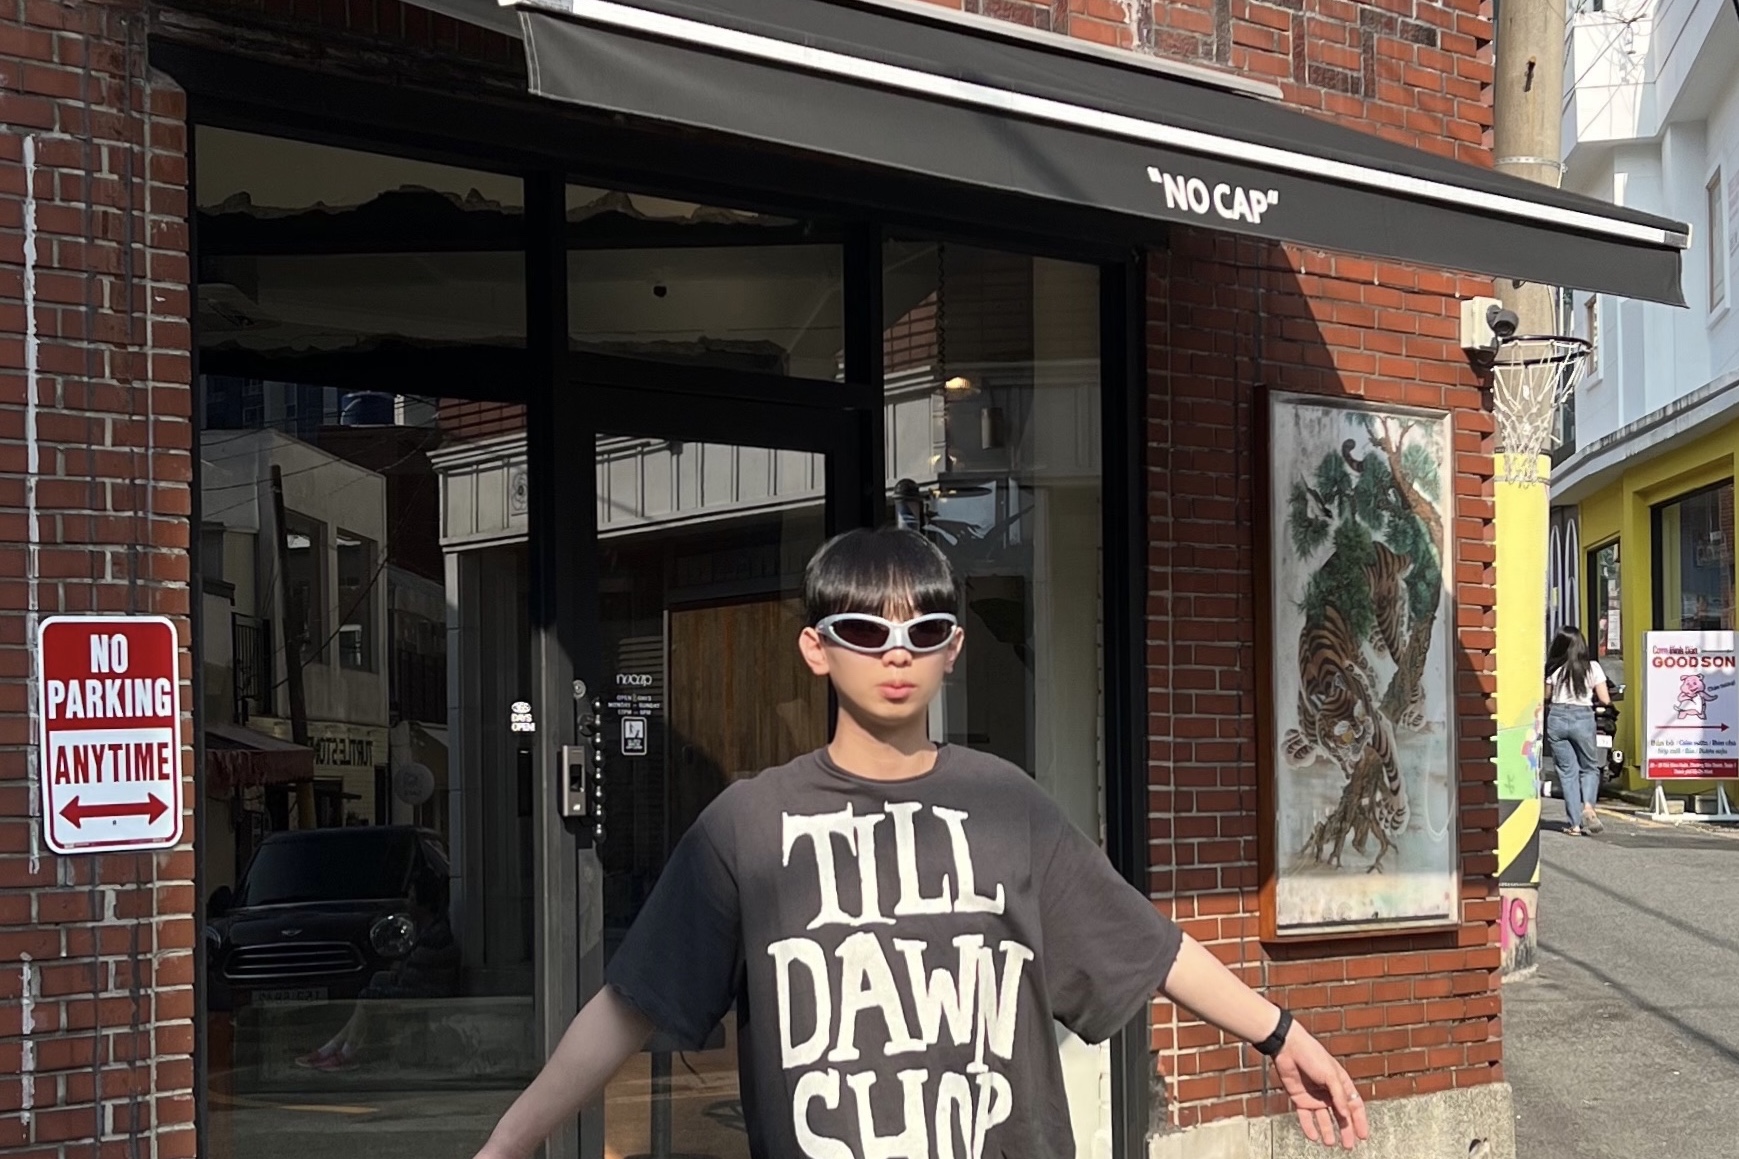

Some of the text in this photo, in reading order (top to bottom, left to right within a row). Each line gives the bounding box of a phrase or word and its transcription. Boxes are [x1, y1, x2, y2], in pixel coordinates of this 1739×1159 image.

[90, 633, 129, 674] NO
[47, 677, 172, 720] PARKING
[54, 742, 171, 785] ANYTIME
[782, 801, 1005, 930] TILL
[767, 931, 1035, 1073] DAWN
